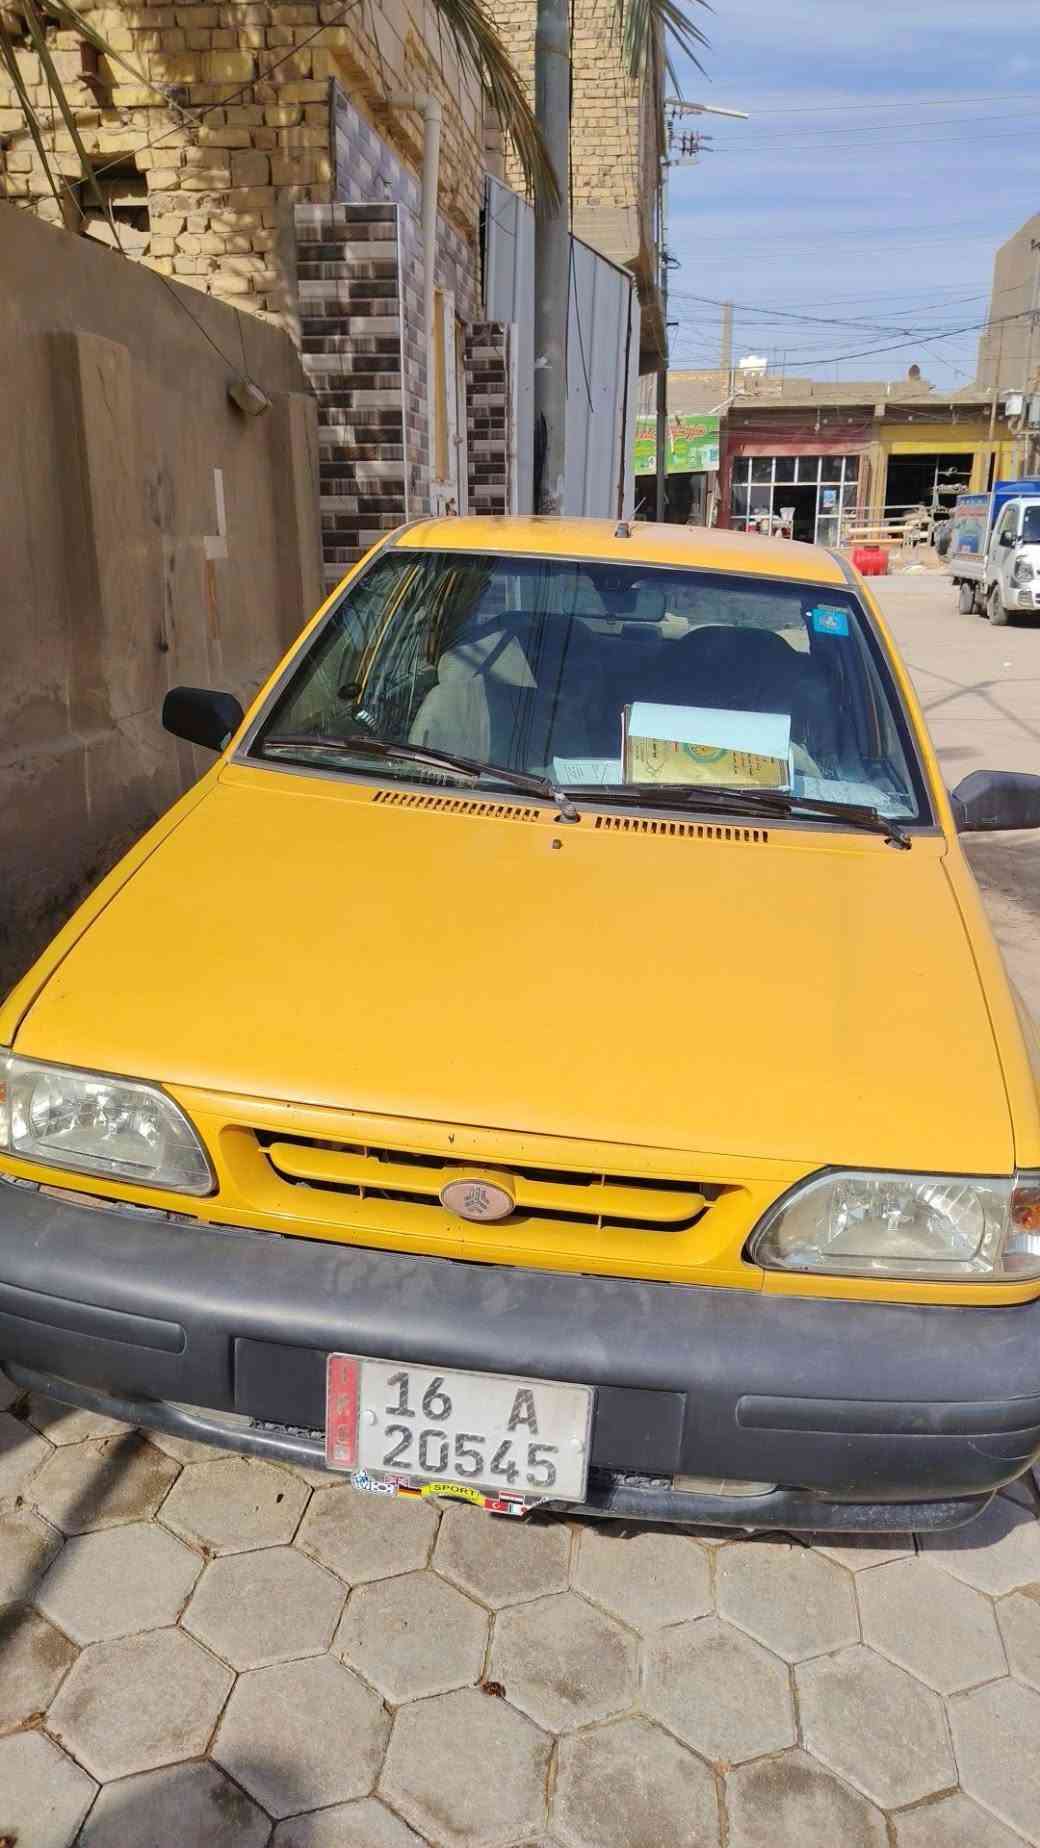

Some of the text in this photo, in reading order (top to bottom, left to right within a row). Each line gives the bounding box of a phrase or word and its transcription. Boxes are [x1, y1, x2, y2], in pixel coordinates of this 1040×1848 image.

[385, 1372, 538, 1435] 16 A
[382, 1424, 559, 1488] 20545
[433, 1484, 475, 1497] SPORT
